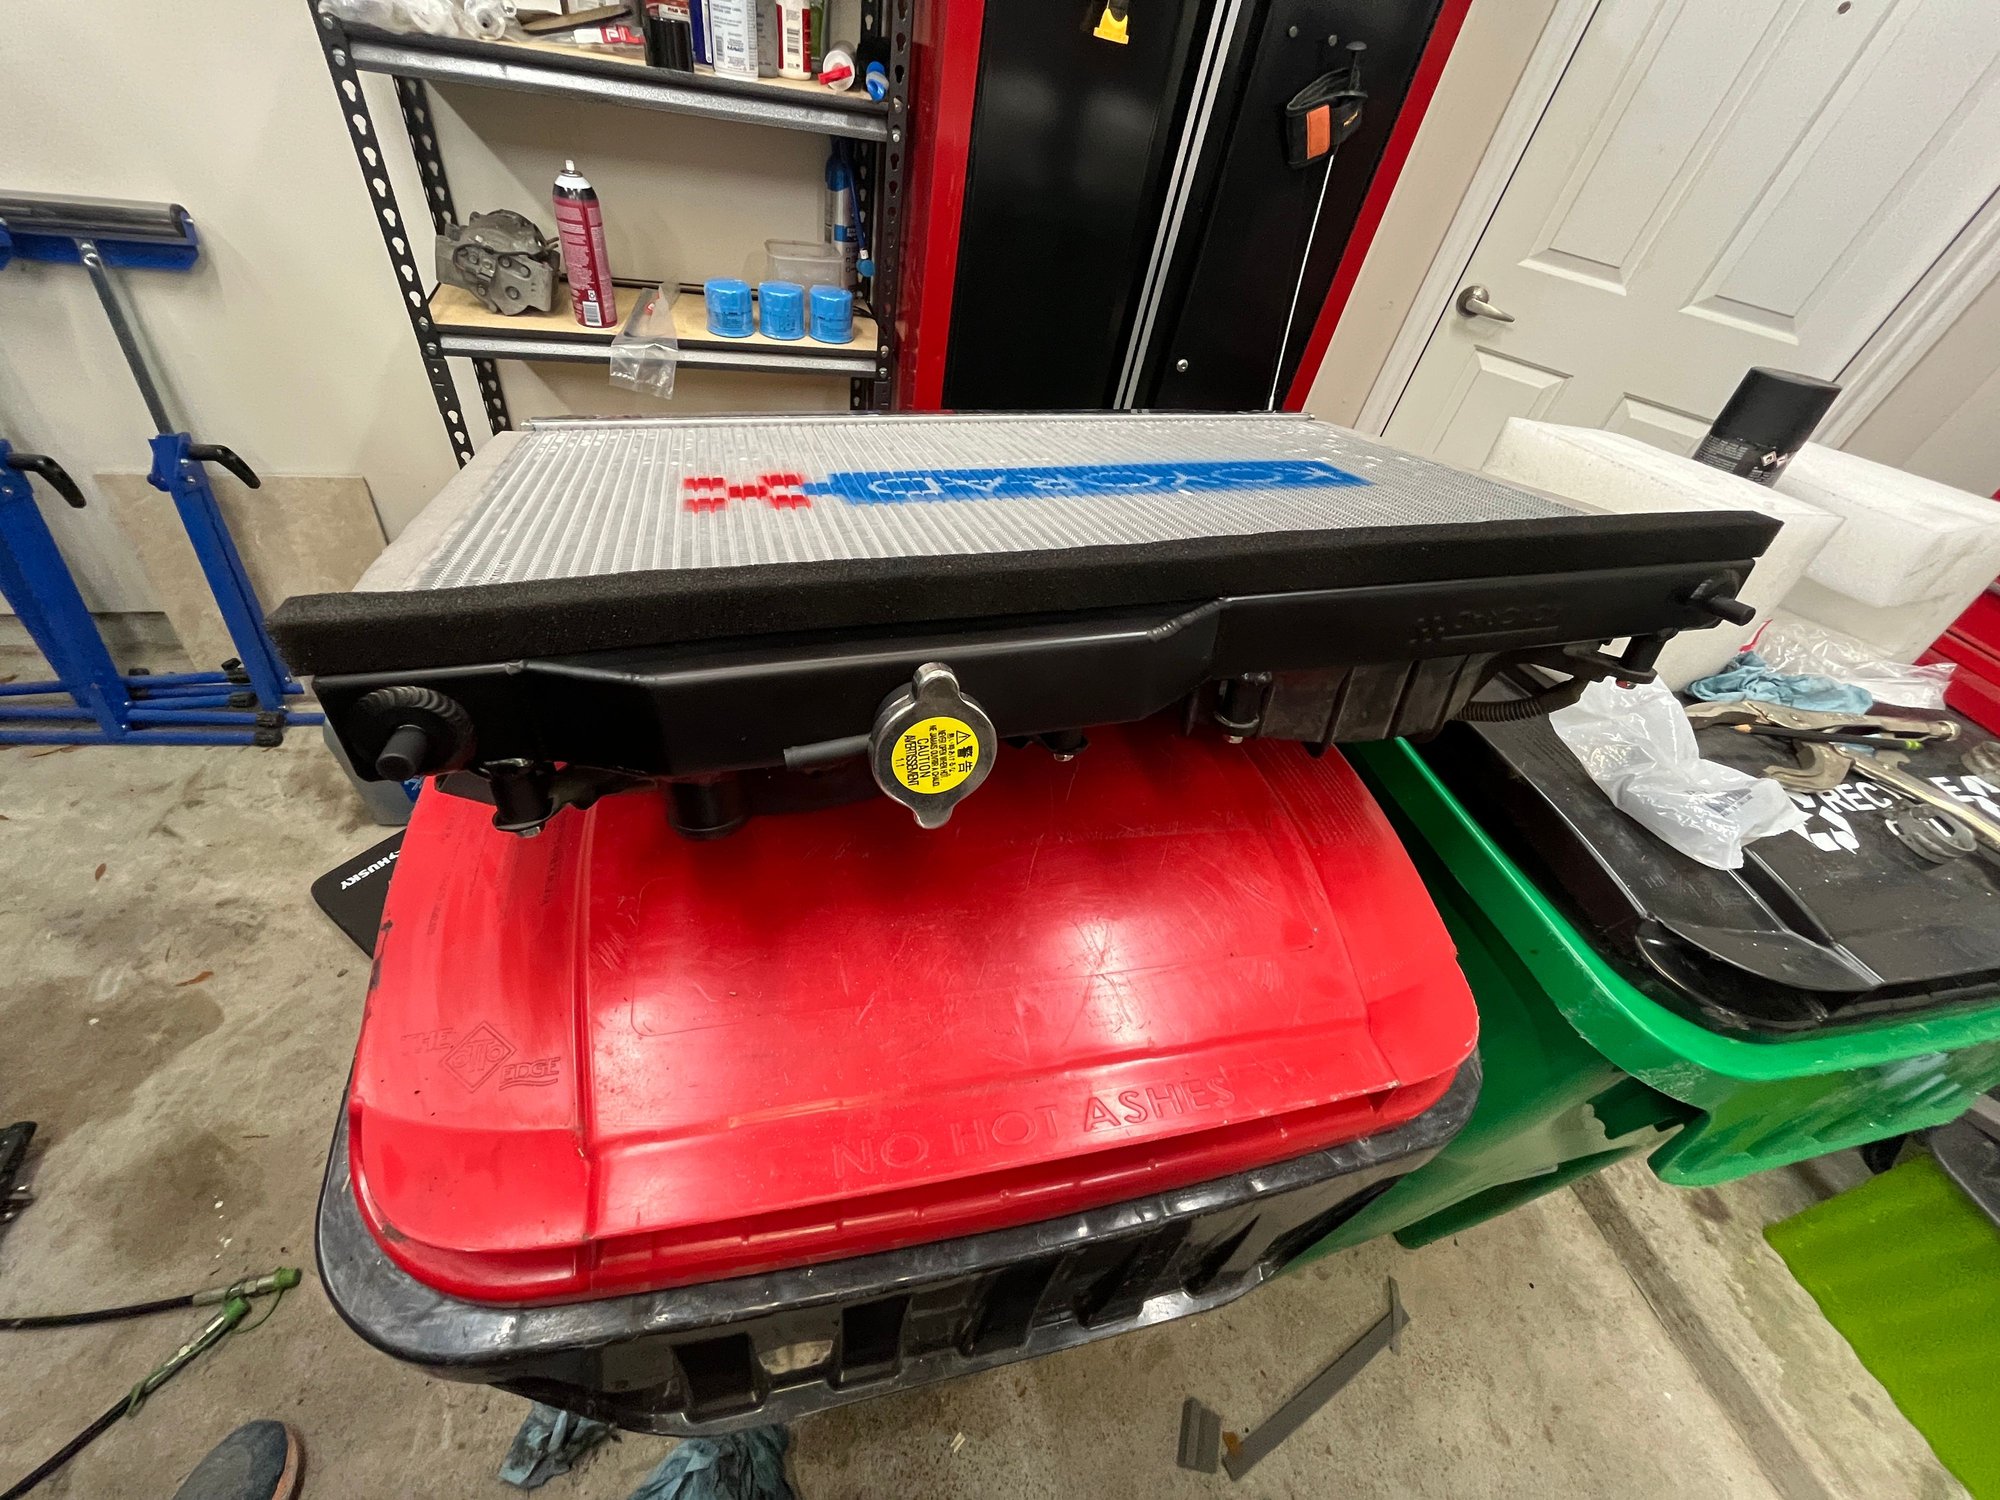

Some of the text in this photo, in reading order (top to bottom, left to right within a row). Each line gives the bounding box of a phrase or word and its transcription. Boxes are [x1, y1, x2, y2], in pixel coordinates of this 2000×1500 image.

[867, 466, 1342, 495] KOYORAD
[904, 735, 920, 786] AVERTISSEMENT
[917, 738, 931, 778] CAUTION
[340, 856, 392, 891] HUSKY
[502, 1057, 561, 1081] EDGE
[831, 1075, 1237, 1180] NO HOT ASHES
